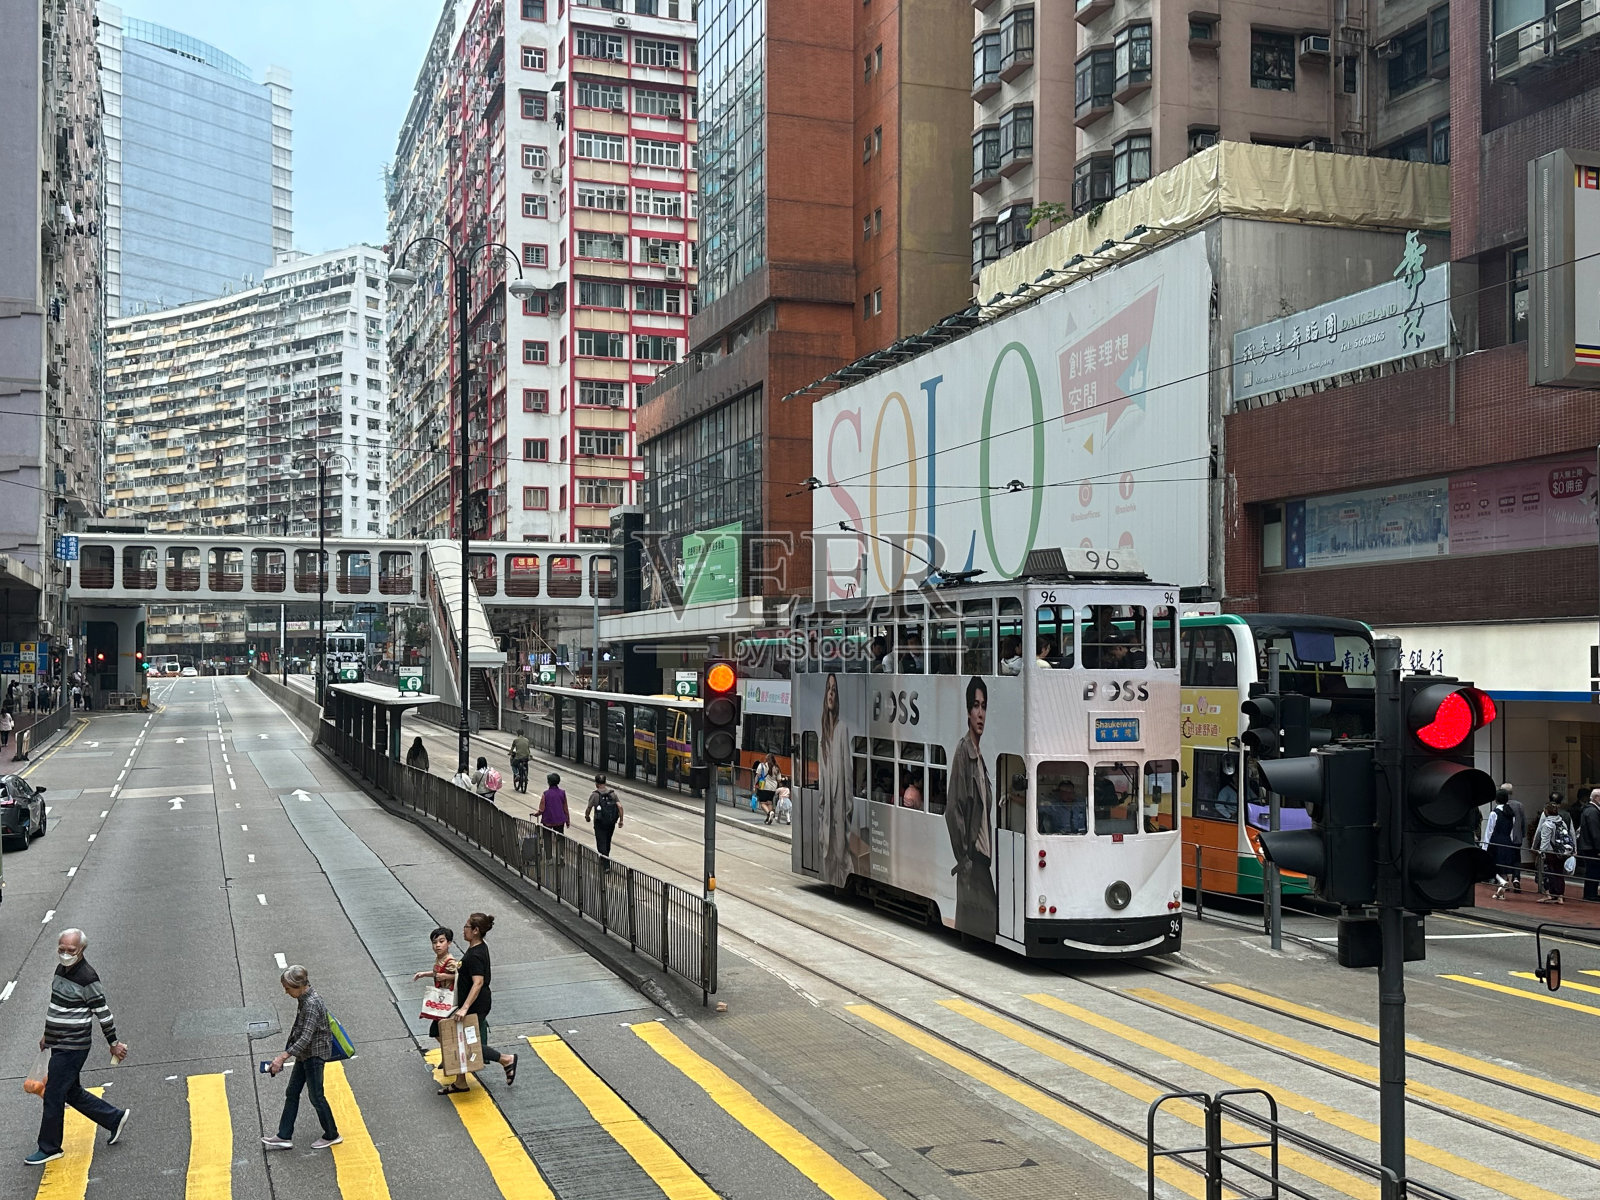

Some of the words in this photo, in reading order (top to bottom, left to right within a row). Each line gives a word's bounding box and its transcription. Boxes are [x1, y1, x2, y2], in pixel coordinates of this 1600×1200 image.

[1341, 304, 1397, 330] DANCELAND
[1069, 333, 1129, 379] 創業理想
[1069, 381, 1097, 411] 空間
[827, 341, 1044, 599] SOLO
[1086, 550, 1119, 570] 96
[1041, 590, 1057, 604] 96
[1164, 592, 1174, 604] 96
[1083, 680, 1149, 702] BOSS
[873, 690, 920, 726] BOSS
[1170, 919, 1180, 932] 96
